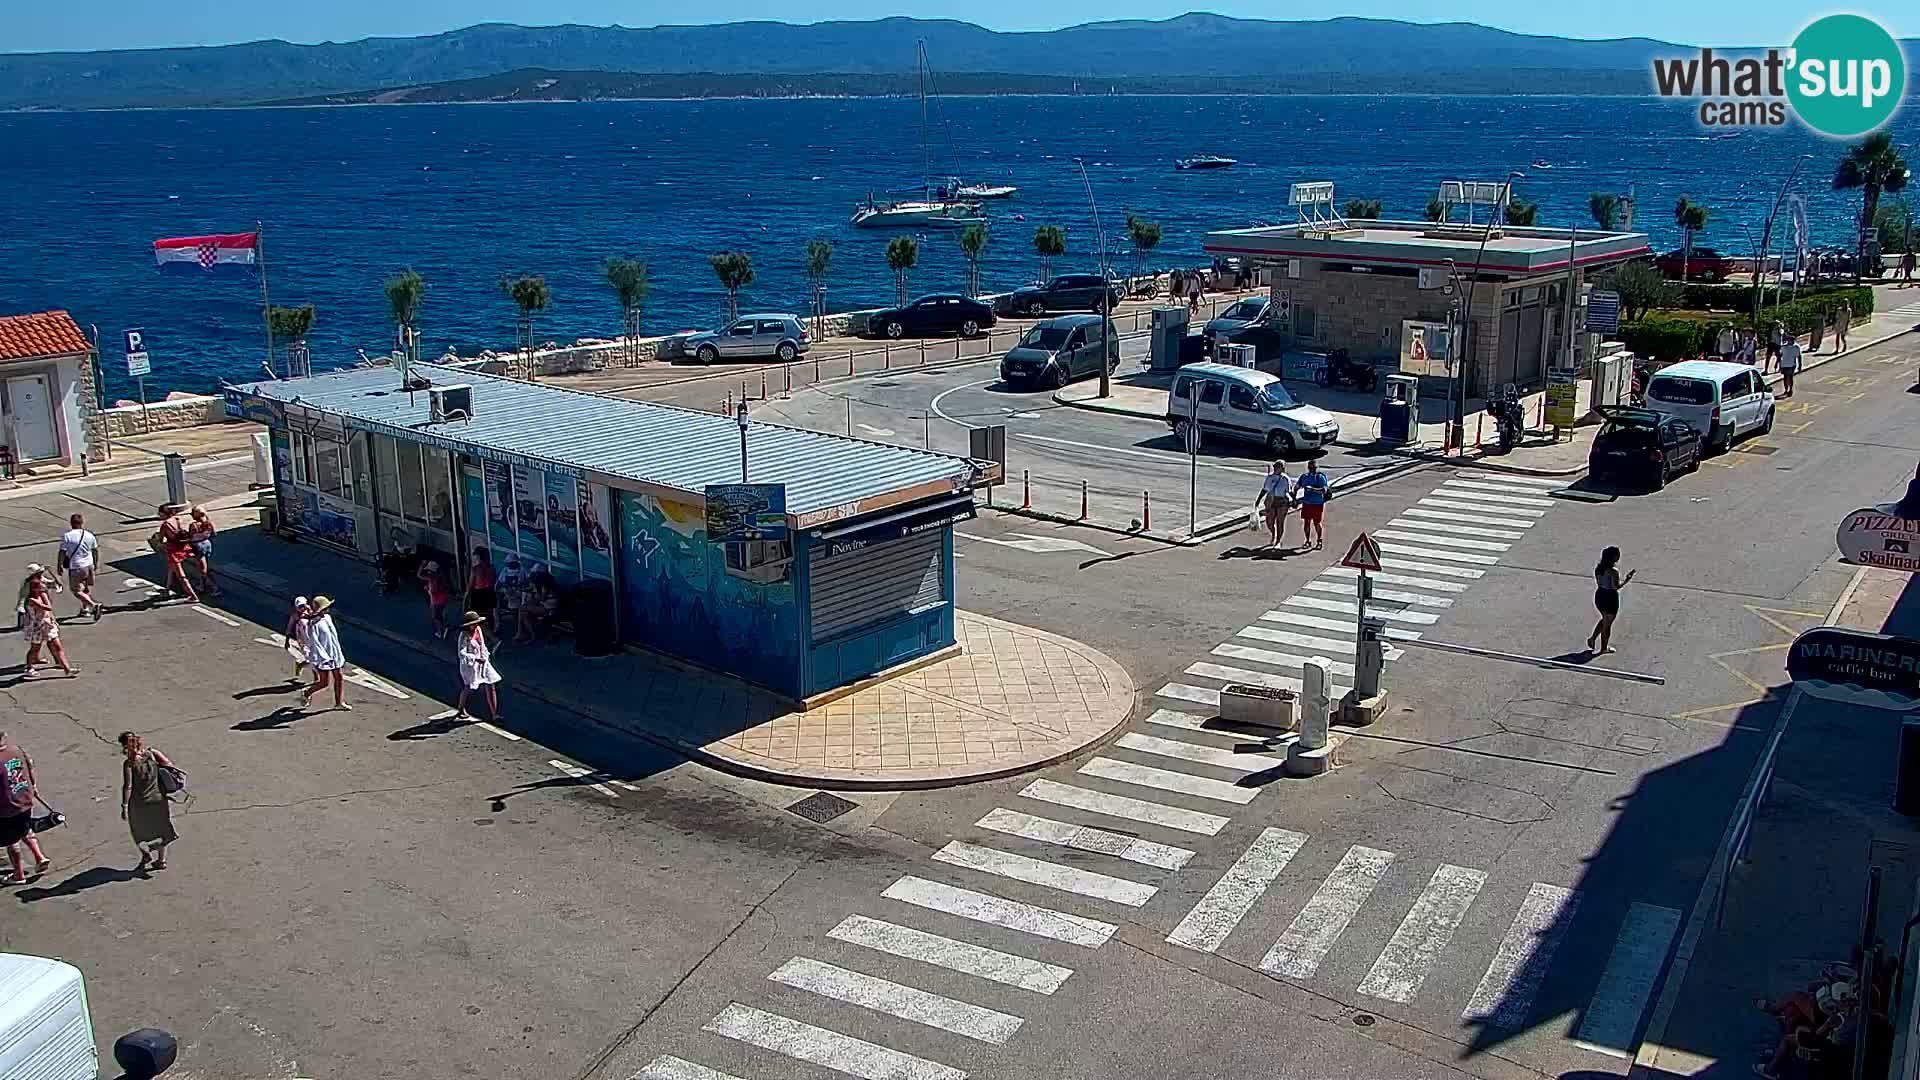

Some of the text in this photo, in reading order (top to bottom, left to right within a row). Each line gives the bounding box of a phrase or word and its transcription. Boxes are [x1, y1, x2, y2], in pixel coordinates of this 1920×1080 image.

[128, 332, 142, 351] P
[493, 451, 525, 466] STATION
[527, 458, 553, 472] TICKET
[554, 463, 583, 479] OFFICE
[1828, 663, 1896, 680] caffe bar
